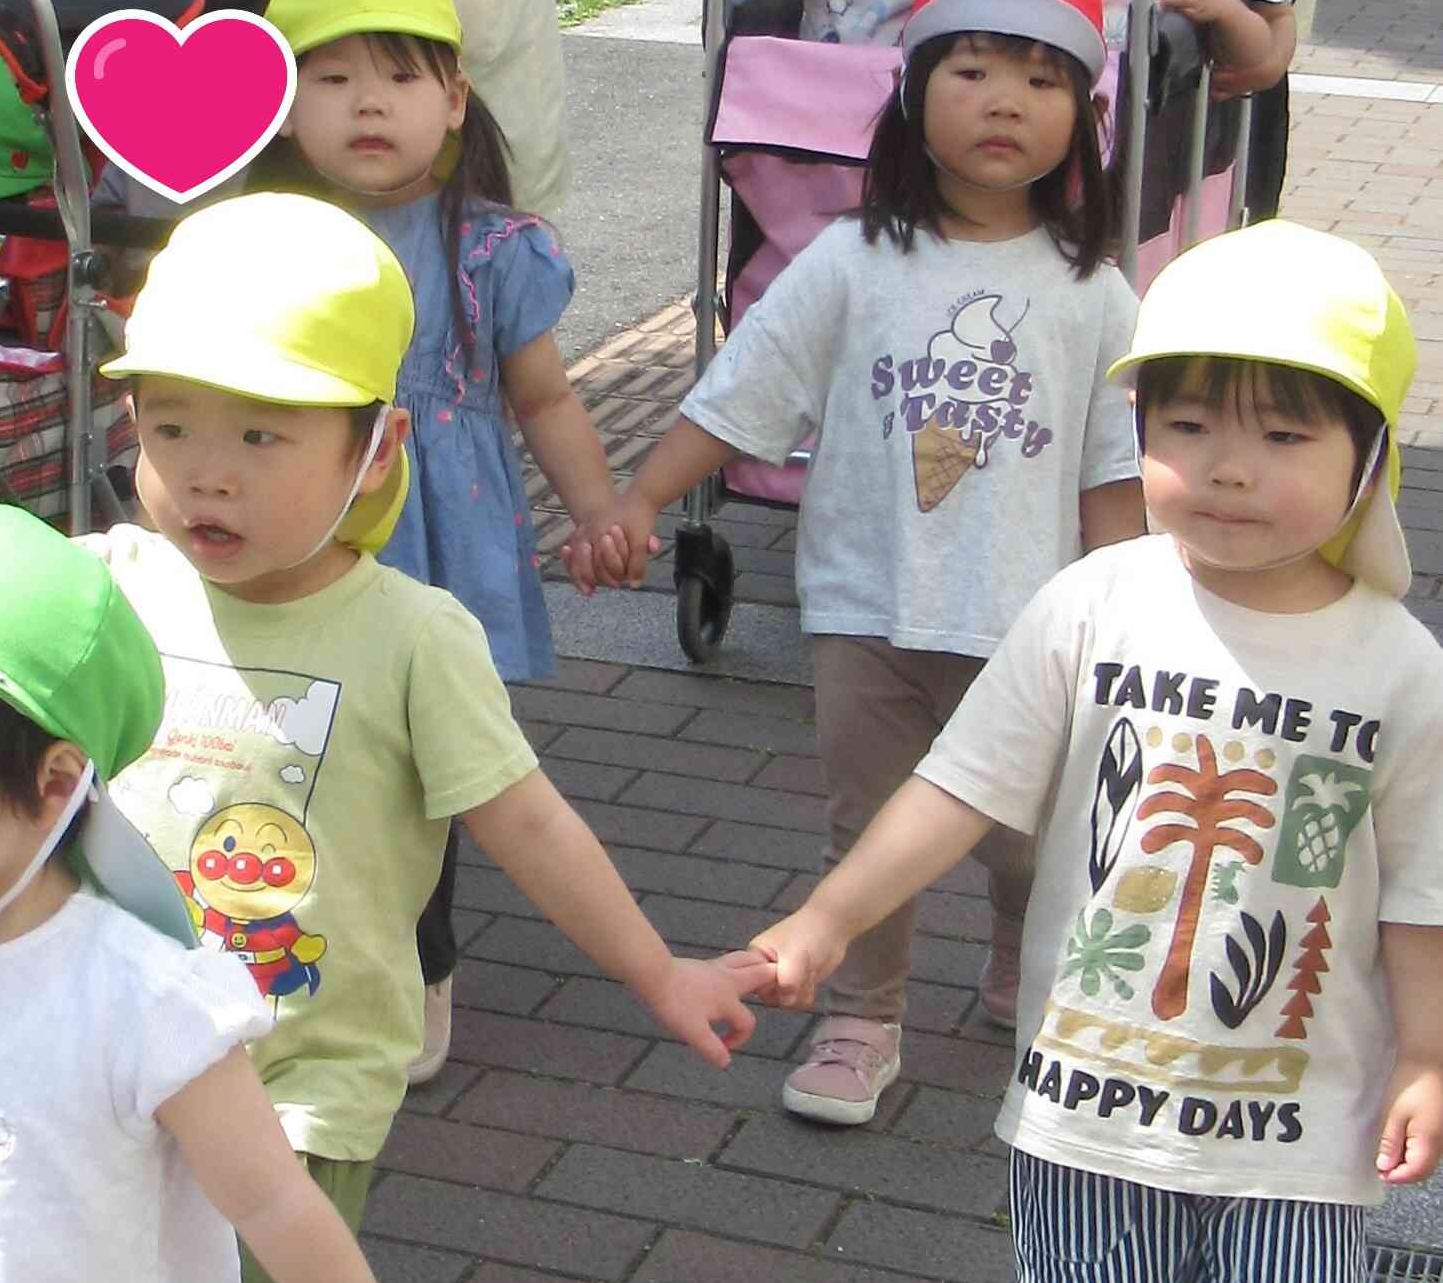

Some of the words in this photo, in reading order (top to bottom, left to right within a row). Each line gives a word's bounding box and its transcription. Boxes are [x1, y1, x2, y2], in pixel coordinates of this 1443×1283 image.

[871, 354, 1032, 405] Sweet
[900, 393, 1052, 458] Tasty
[1093, 662, 1220, 720] TAKE
[1231, 687, 1313, 743] ME
[1018, 1046, 1170, 1127] HAPPY
[1178, 1096, 1303, 1144] DAYS
